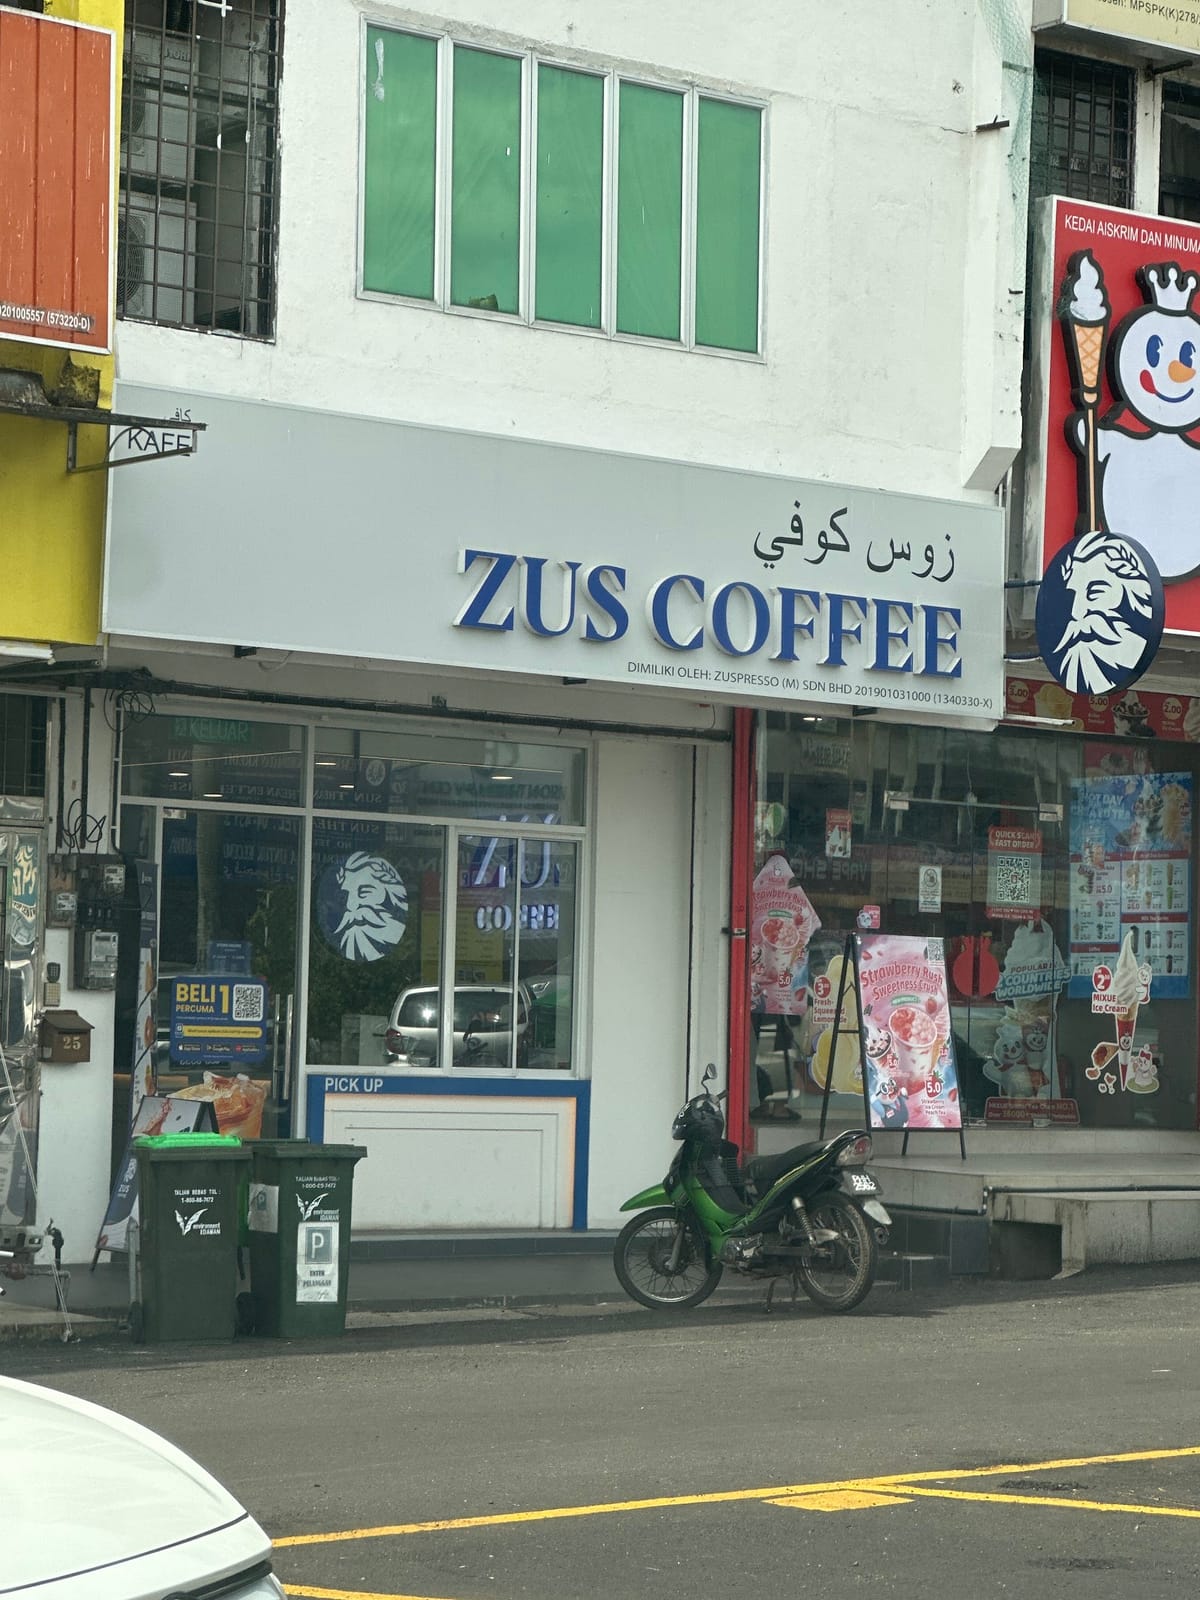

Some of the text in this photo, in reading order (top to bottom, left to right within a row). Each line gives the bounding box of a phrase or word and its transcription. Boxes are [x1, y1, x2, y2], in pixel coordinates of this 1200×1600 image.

[1065, 214, 1095, 233] KEDAI
[1097, 222, 1138, 242] AISKRIM
[1140, 229, 1161, 247] DAN
[0, 305, 90, 331] 201005557 (573220-D)
[753, 500, 955, 583] زوس كوفي
[452, 548, 962, 679] ZUS COFFEE
[627, 661, 675, 677] DIMILIKI
[677, 667, 711, 681] OLEH:
[714, 670, 779, 687] ZUSPRESSO
[782, 678, 799, 691] (M)
[803, 680, 826, 692] SDN
[829, 684, 852, 695] BHD
[855, 685, 931, 702] 201901031000
[933, 693, 993, 710] (1340330-X)
[1009, 686, 1029, 698] 3.00
[1090, 694, 1108, 706] 5.00
[1164, 704, 1182, 714] 2.00
[190, 720, 249, 741] KELUAR
[995, 831, 1016, 839] QUICK
[995, 839, 1010, 847] FAST
[861, 961, 943, 987] Strawberry Rush
[1010, 963, 1047, 973] POPULAR
[779, 976, 791, 985] 5.0
[1005, 968, 1071, 986] COUNTRIES
[873, 980, 917, 1000] Sweetness
[919, 980, 938, 994] Crush
[176, 983, 229, 1014] BELI 1
[1093, 994, 1117, 1002] MIXUE
[176, 1004, 215, 1013] PERCUMA
[63, 1036, 81, 1050] 25
[325, 1077, 384, 1092] PICK UP
[927, 1081, 940, 1093] 5.0
[311, 1232, 325, 1259] P
